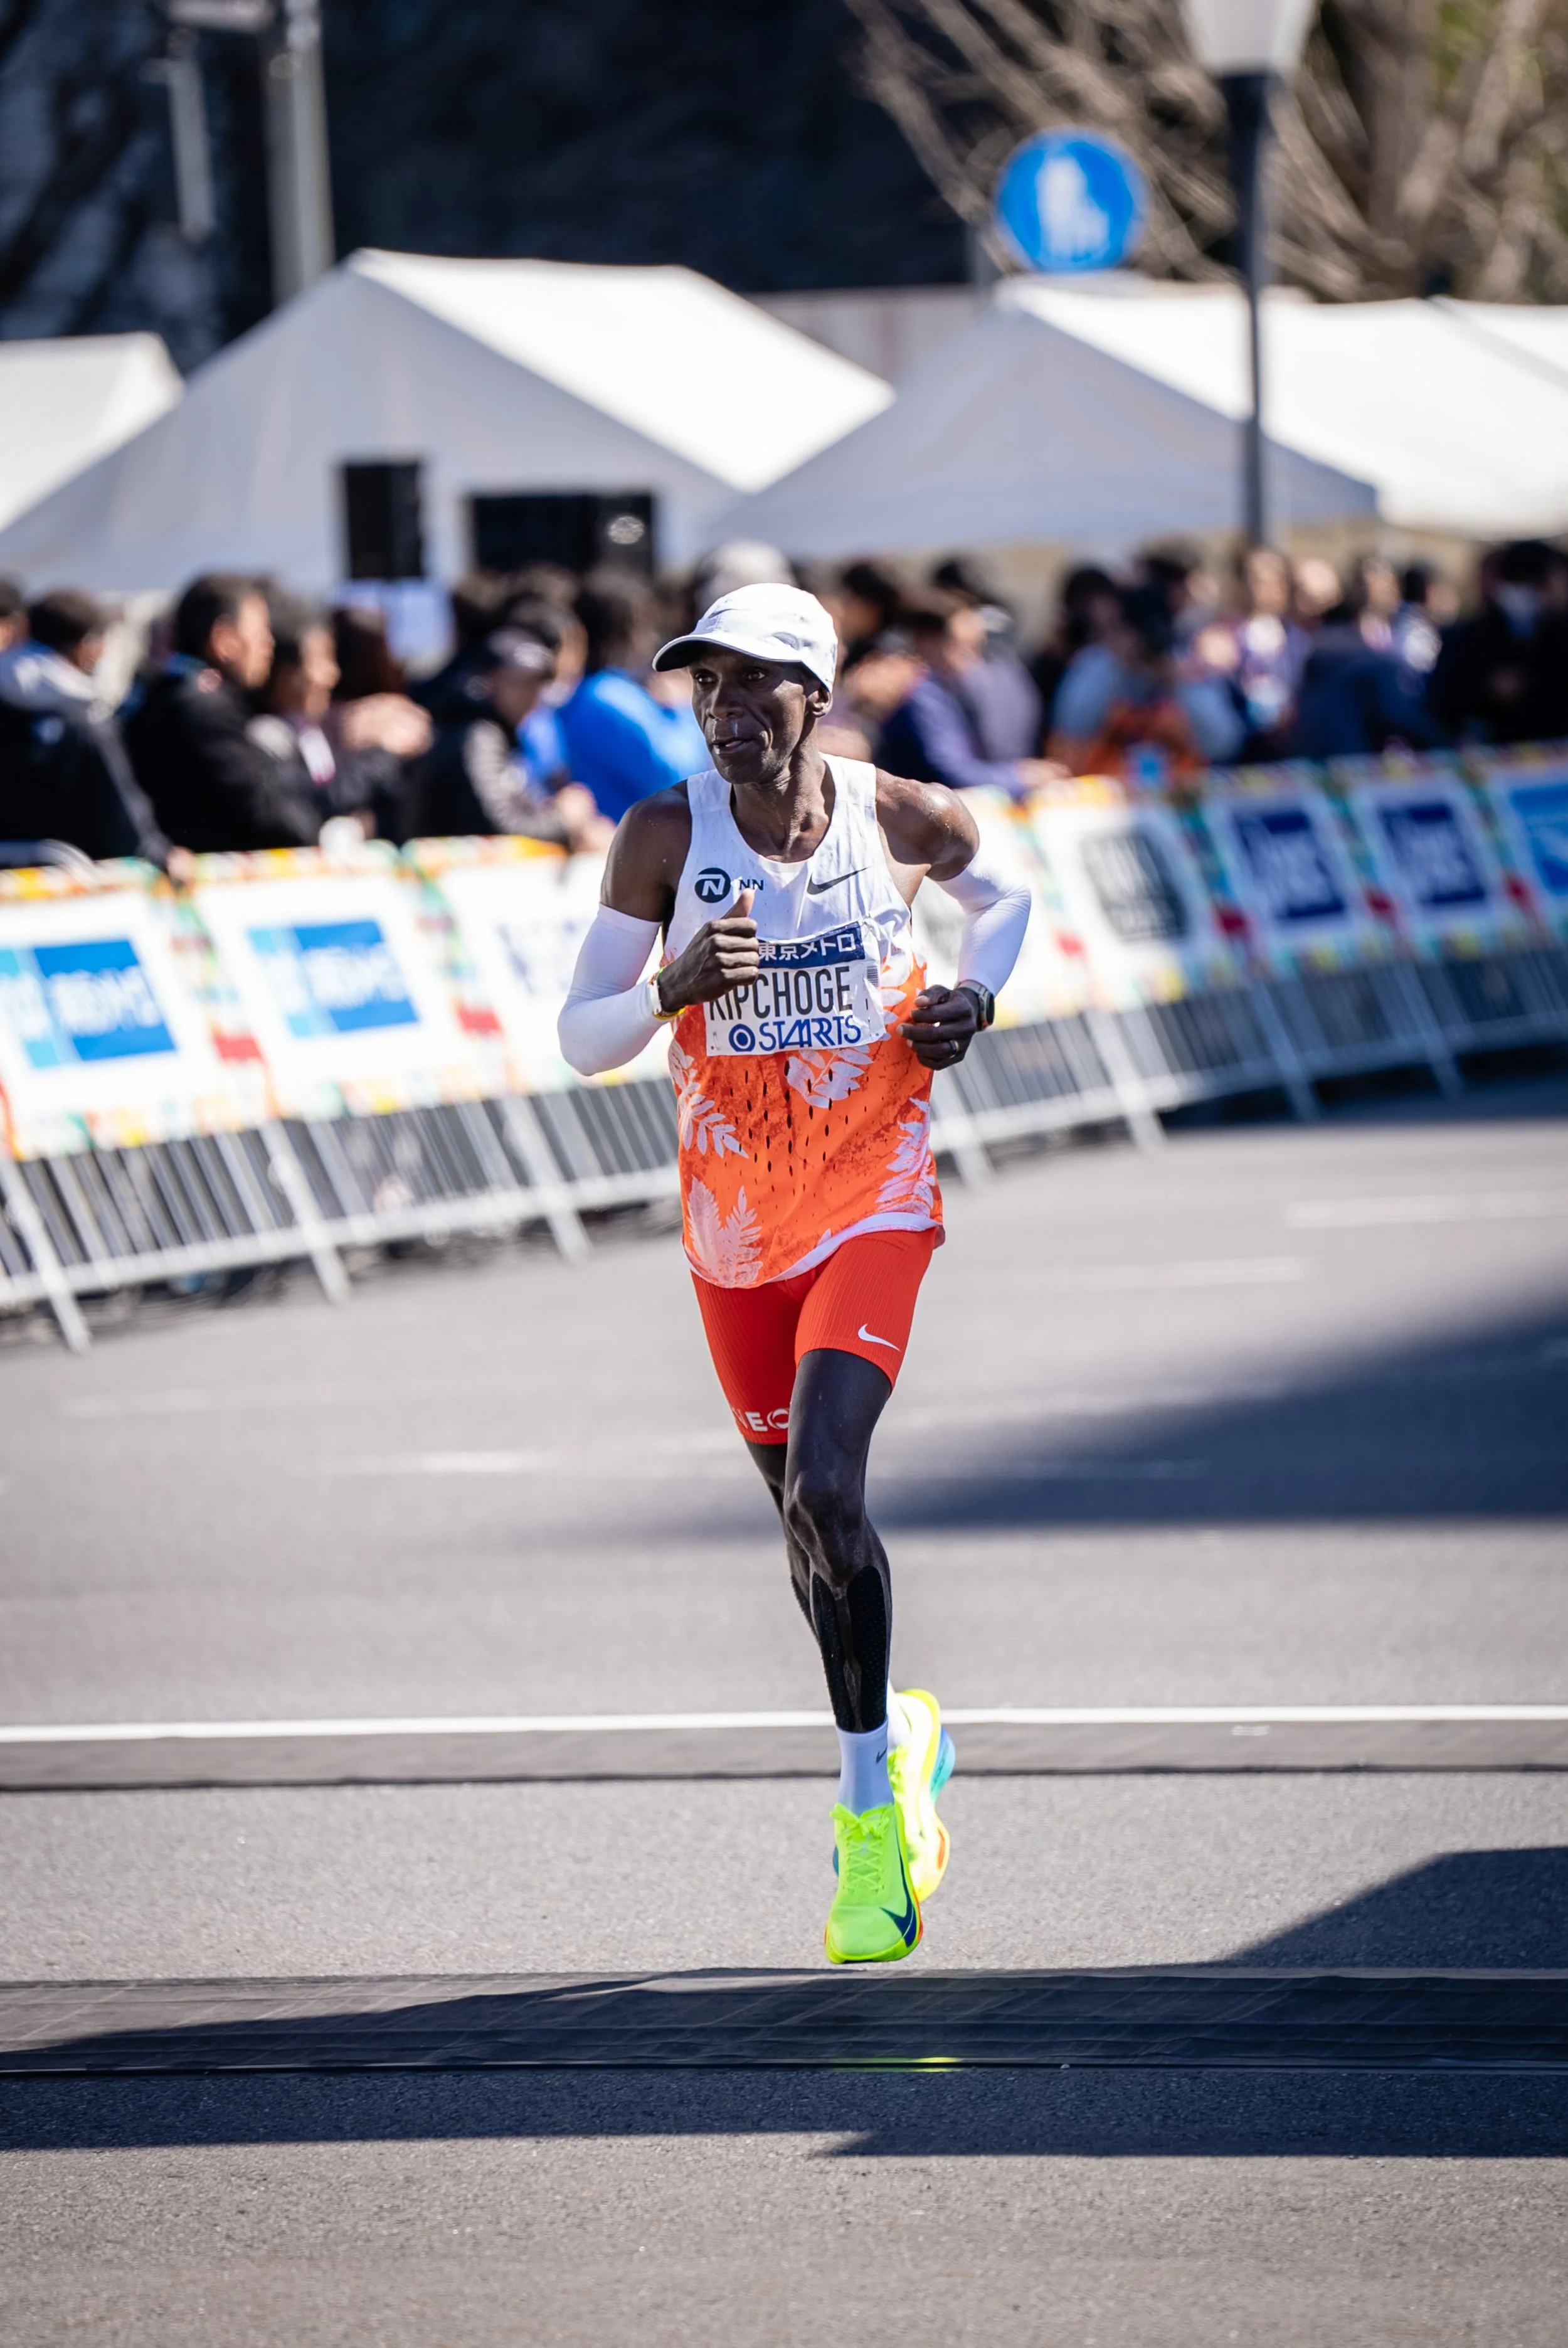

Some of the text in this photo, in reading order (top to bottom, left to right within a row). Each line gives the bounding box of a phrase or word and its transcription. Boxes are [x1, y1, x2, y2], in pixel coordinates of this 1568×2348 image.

[739, 879, 764, 891] NN
[758, 933, 857, 962] 東京メトロ
